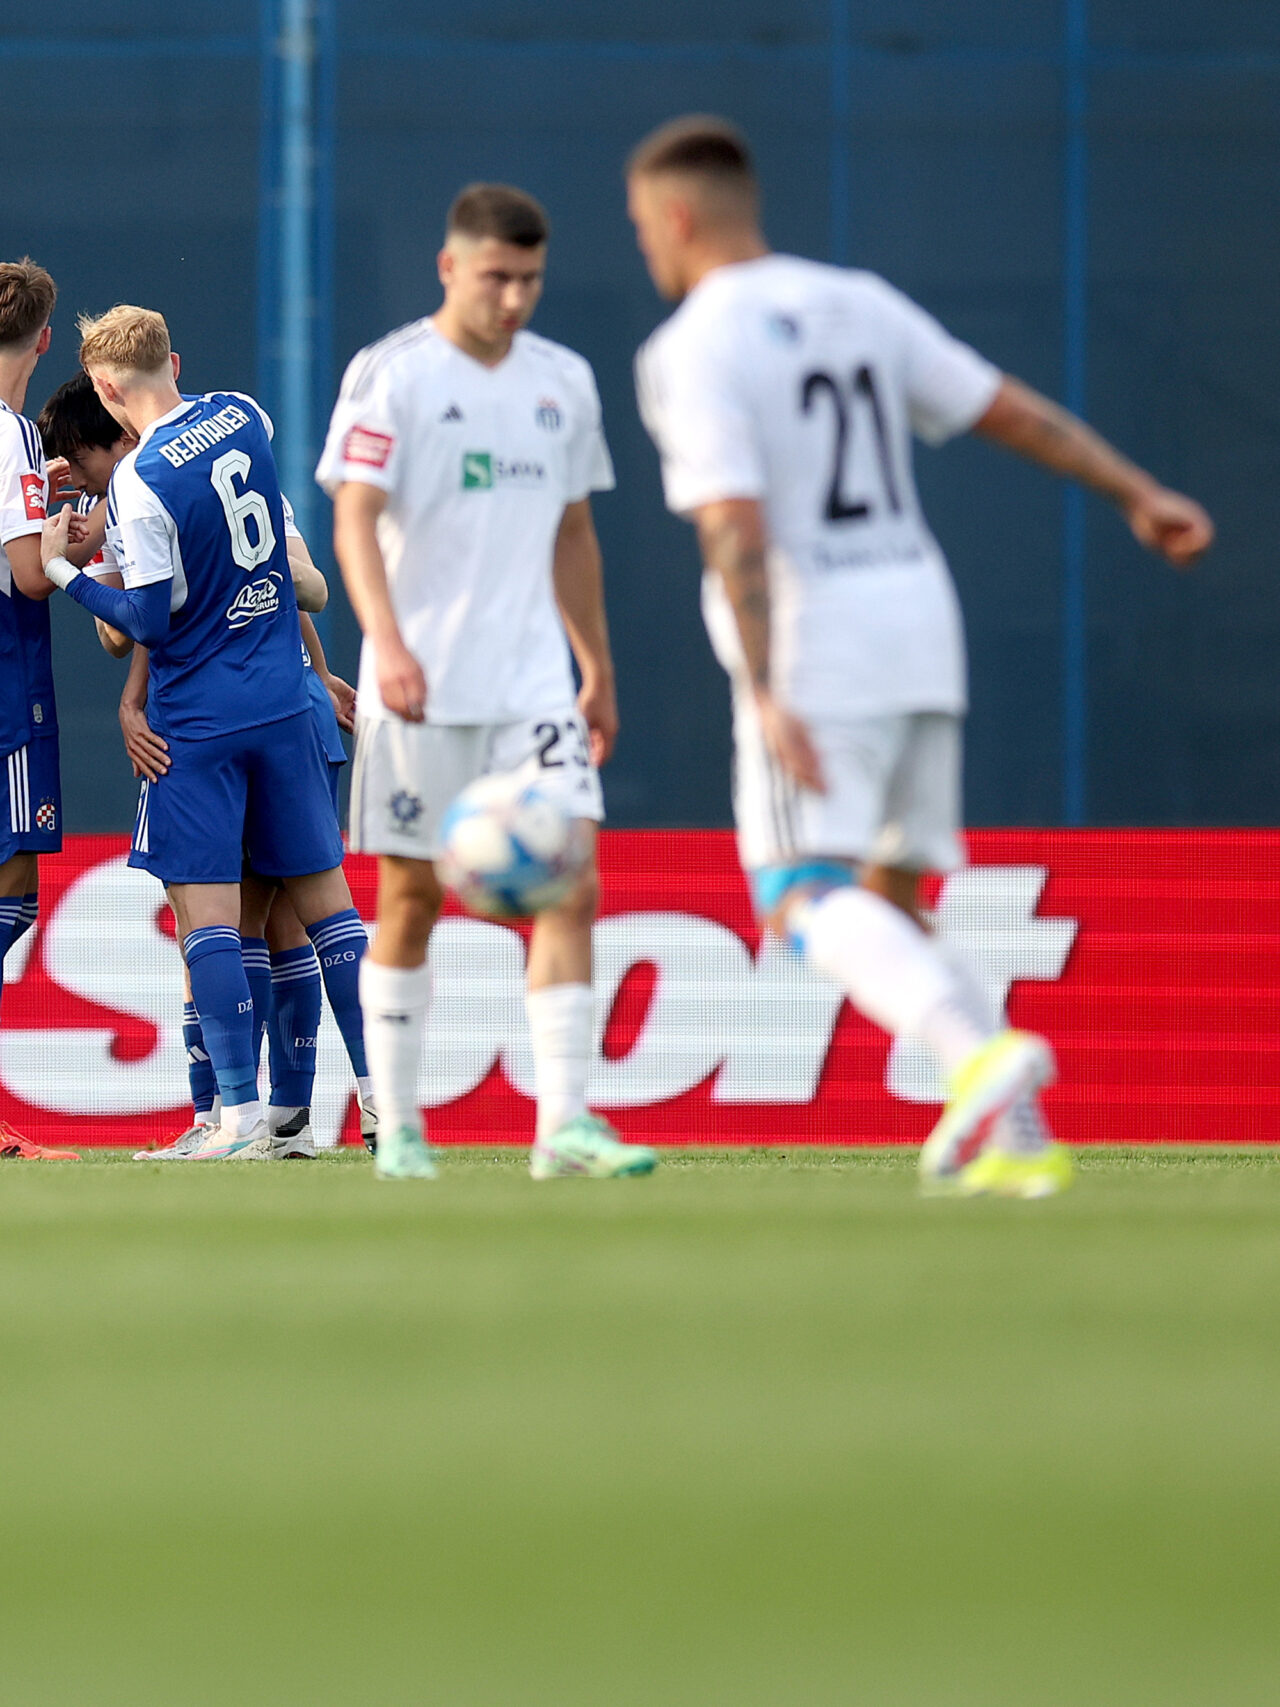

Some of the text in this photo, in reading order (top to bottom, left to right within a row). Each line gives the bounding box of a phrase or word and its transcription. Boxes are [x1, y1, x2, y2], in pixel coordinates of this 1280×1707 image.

[158, 404, 251, 469] BERNAUER
[799, 361, 903, 522] 21
[210, 448, 276, 572] 6
[324, 950, 356, 968] DZG
